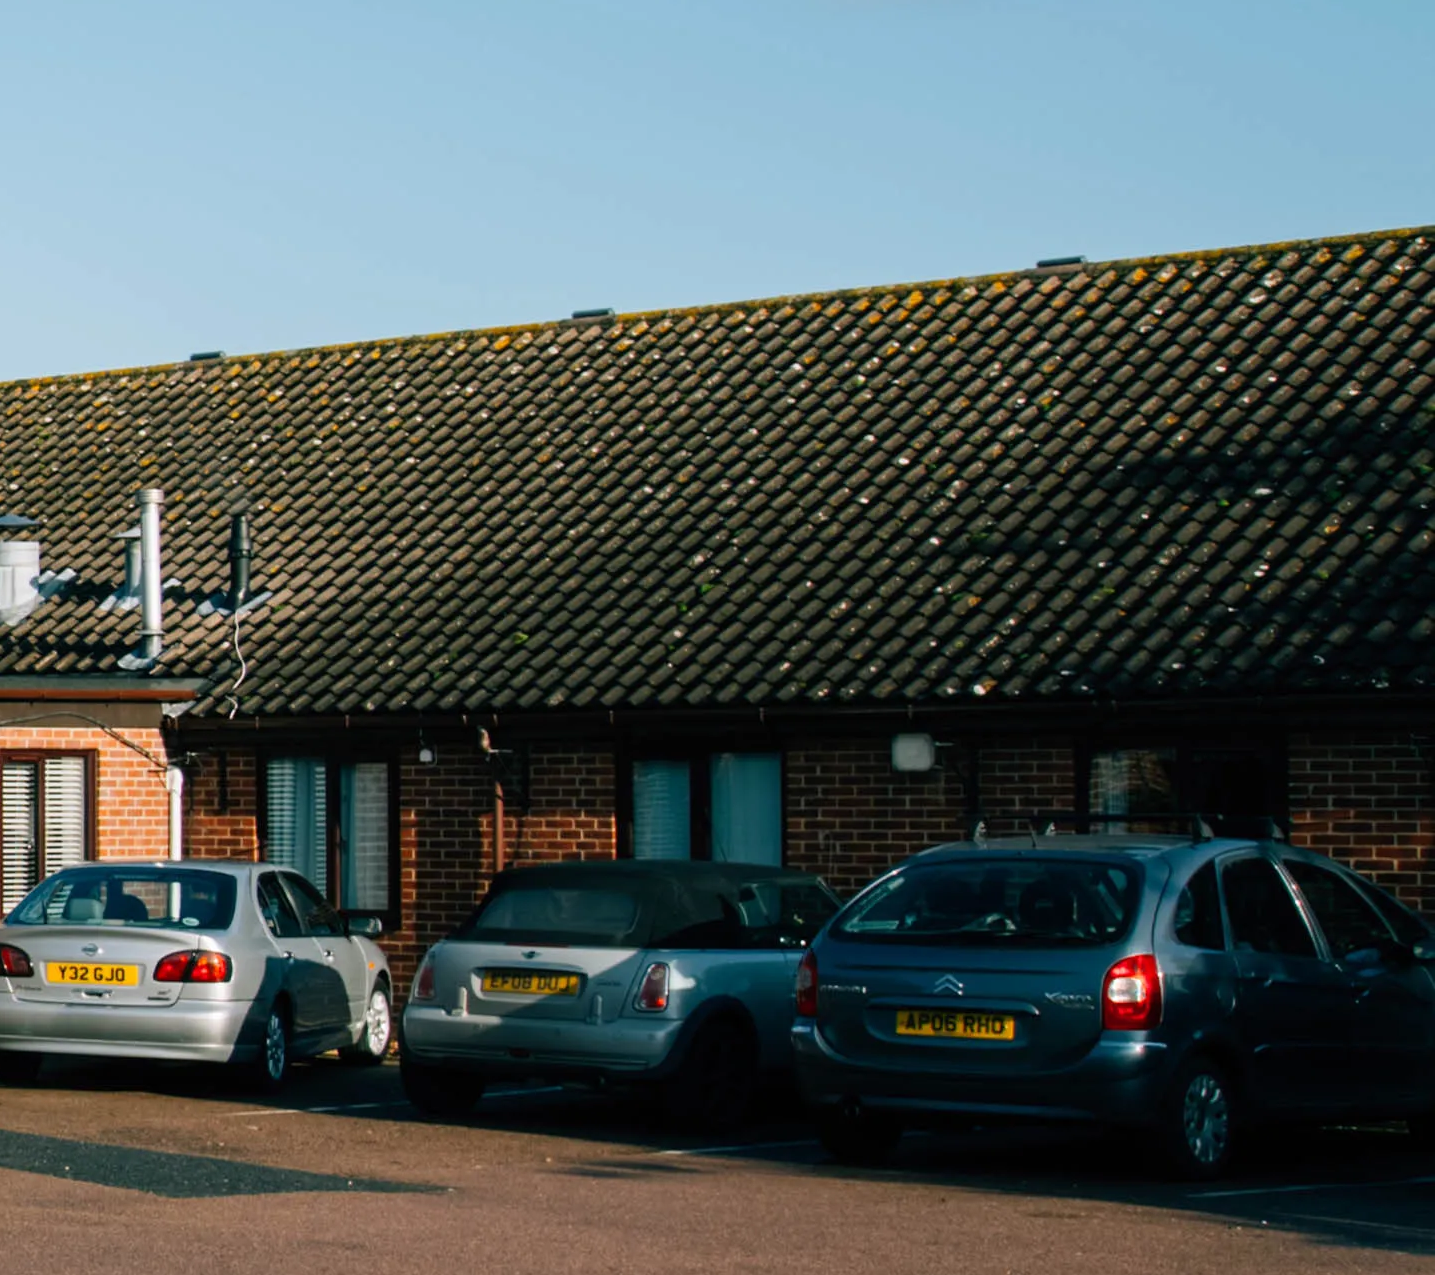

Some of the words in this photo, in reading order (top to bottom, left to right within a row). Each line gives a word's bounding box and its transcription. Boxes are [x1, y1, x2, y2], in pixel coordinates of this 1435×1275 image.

[58, 966, 89, 981] Y32
[93, 967, 125, 982] GJO
[905, 1012, 956, 1032] AP06
[963, 1014, 1005, 1035] RHO
